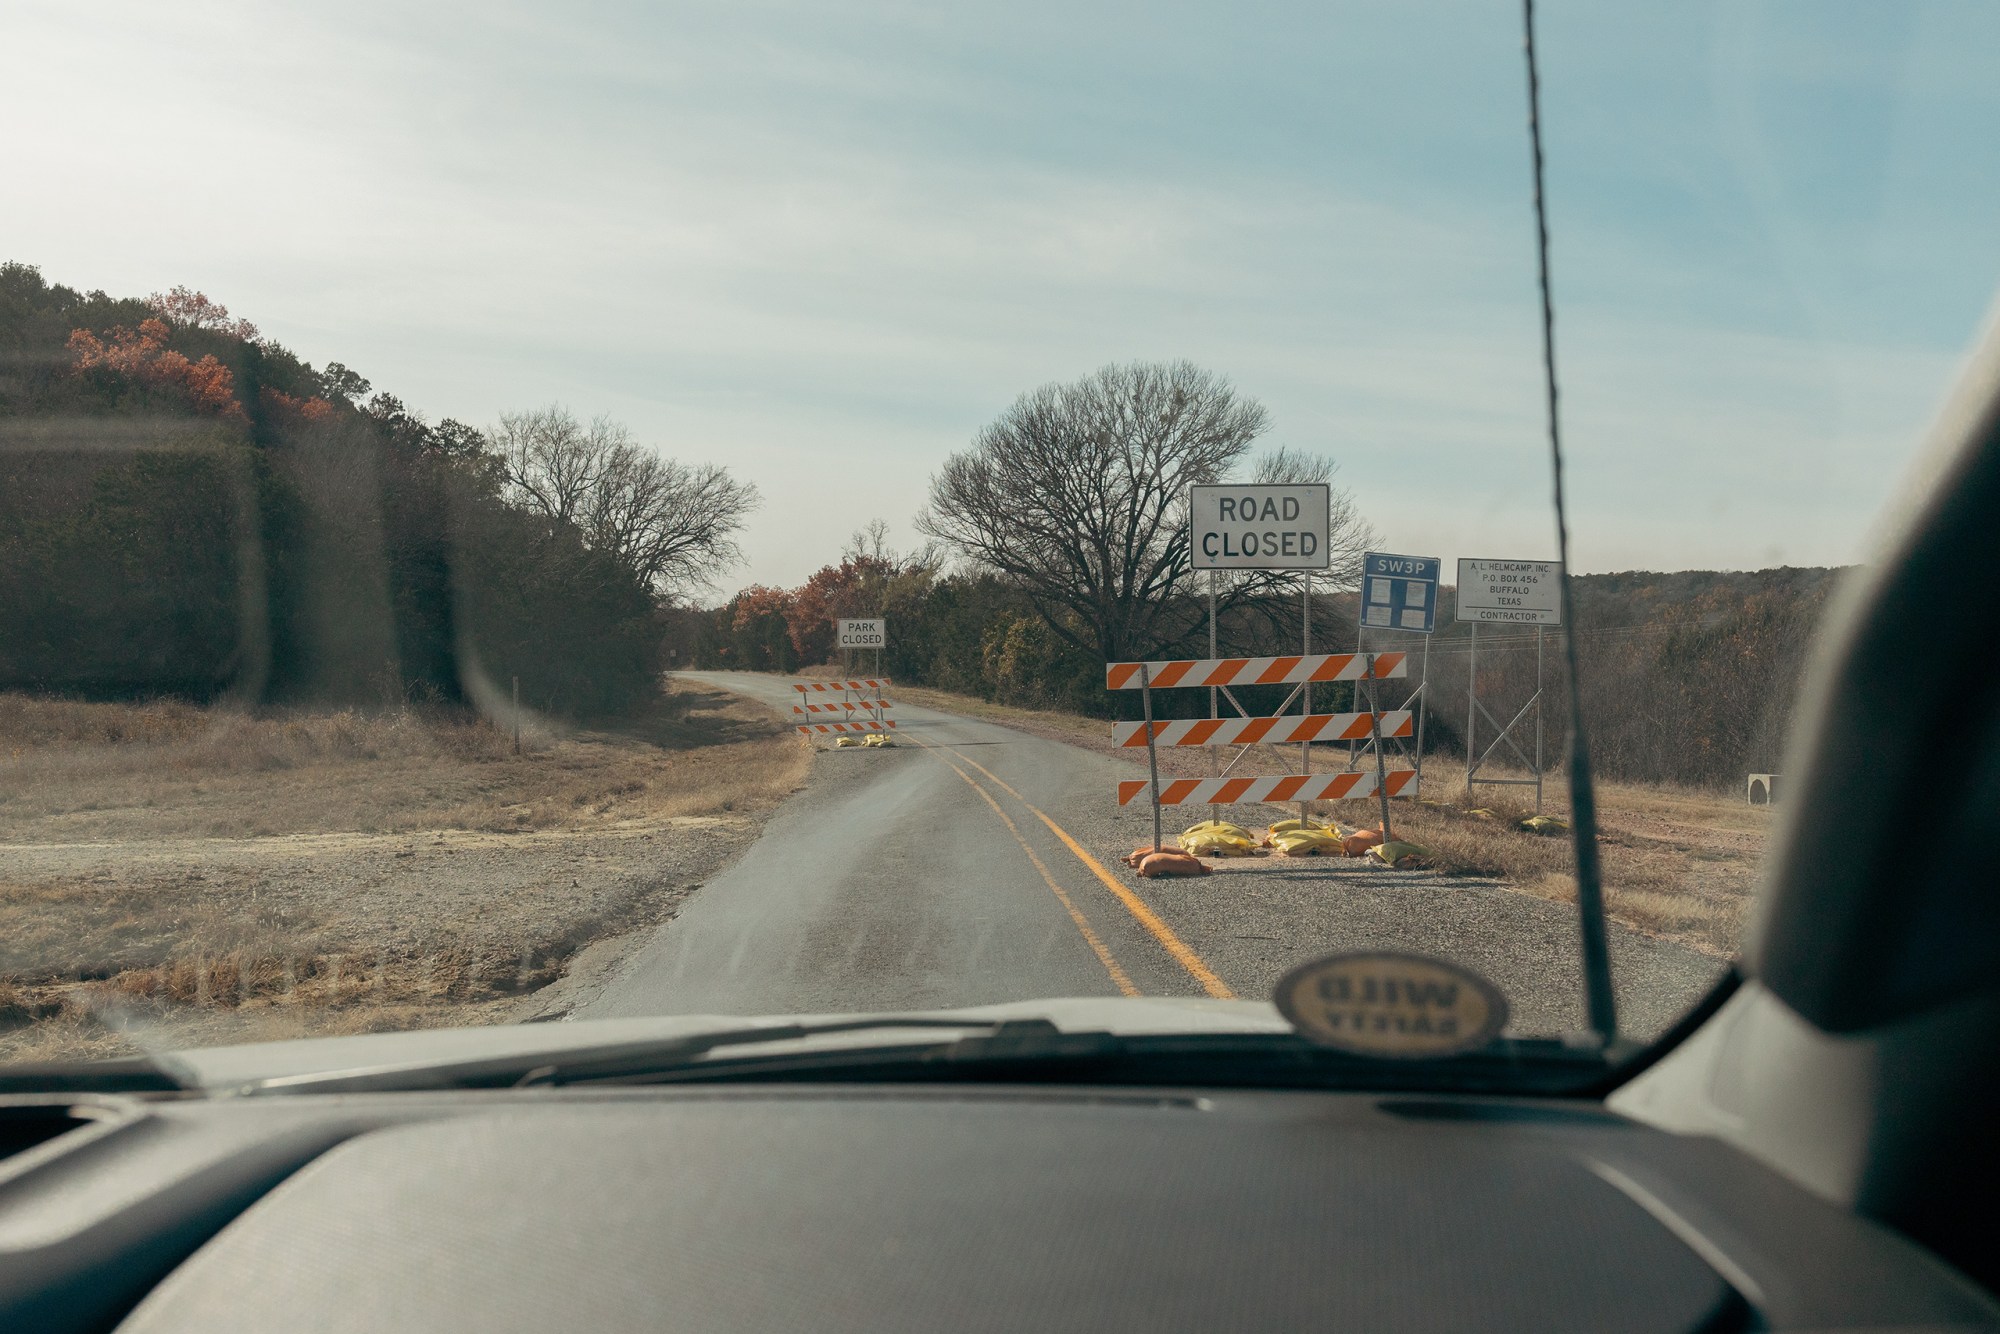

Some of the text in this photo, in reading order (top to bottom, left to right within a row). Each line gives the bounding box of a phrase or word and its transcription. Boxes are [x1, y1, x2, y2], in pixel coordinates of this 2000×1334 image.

[1219, 496, 1300, 522] ROAD
[1202, 531, 1318, 557] CLOSED
[1378, 559, 1425, 575] SW3P
[1535, 564, 1551, 573] INC.
[1500, 574, 1518, 583] BOX
[1519, 575, 1538, 584] 456
[1489, 585, 1530, 595] BUFFALO
[1497, 597, 1522, 606] TEXAS
[1480, 611, 1537, 621] CONTRACTOR
[848, 622, 876, 632] PARK
[842, 634, 882, 644] CLOSED
